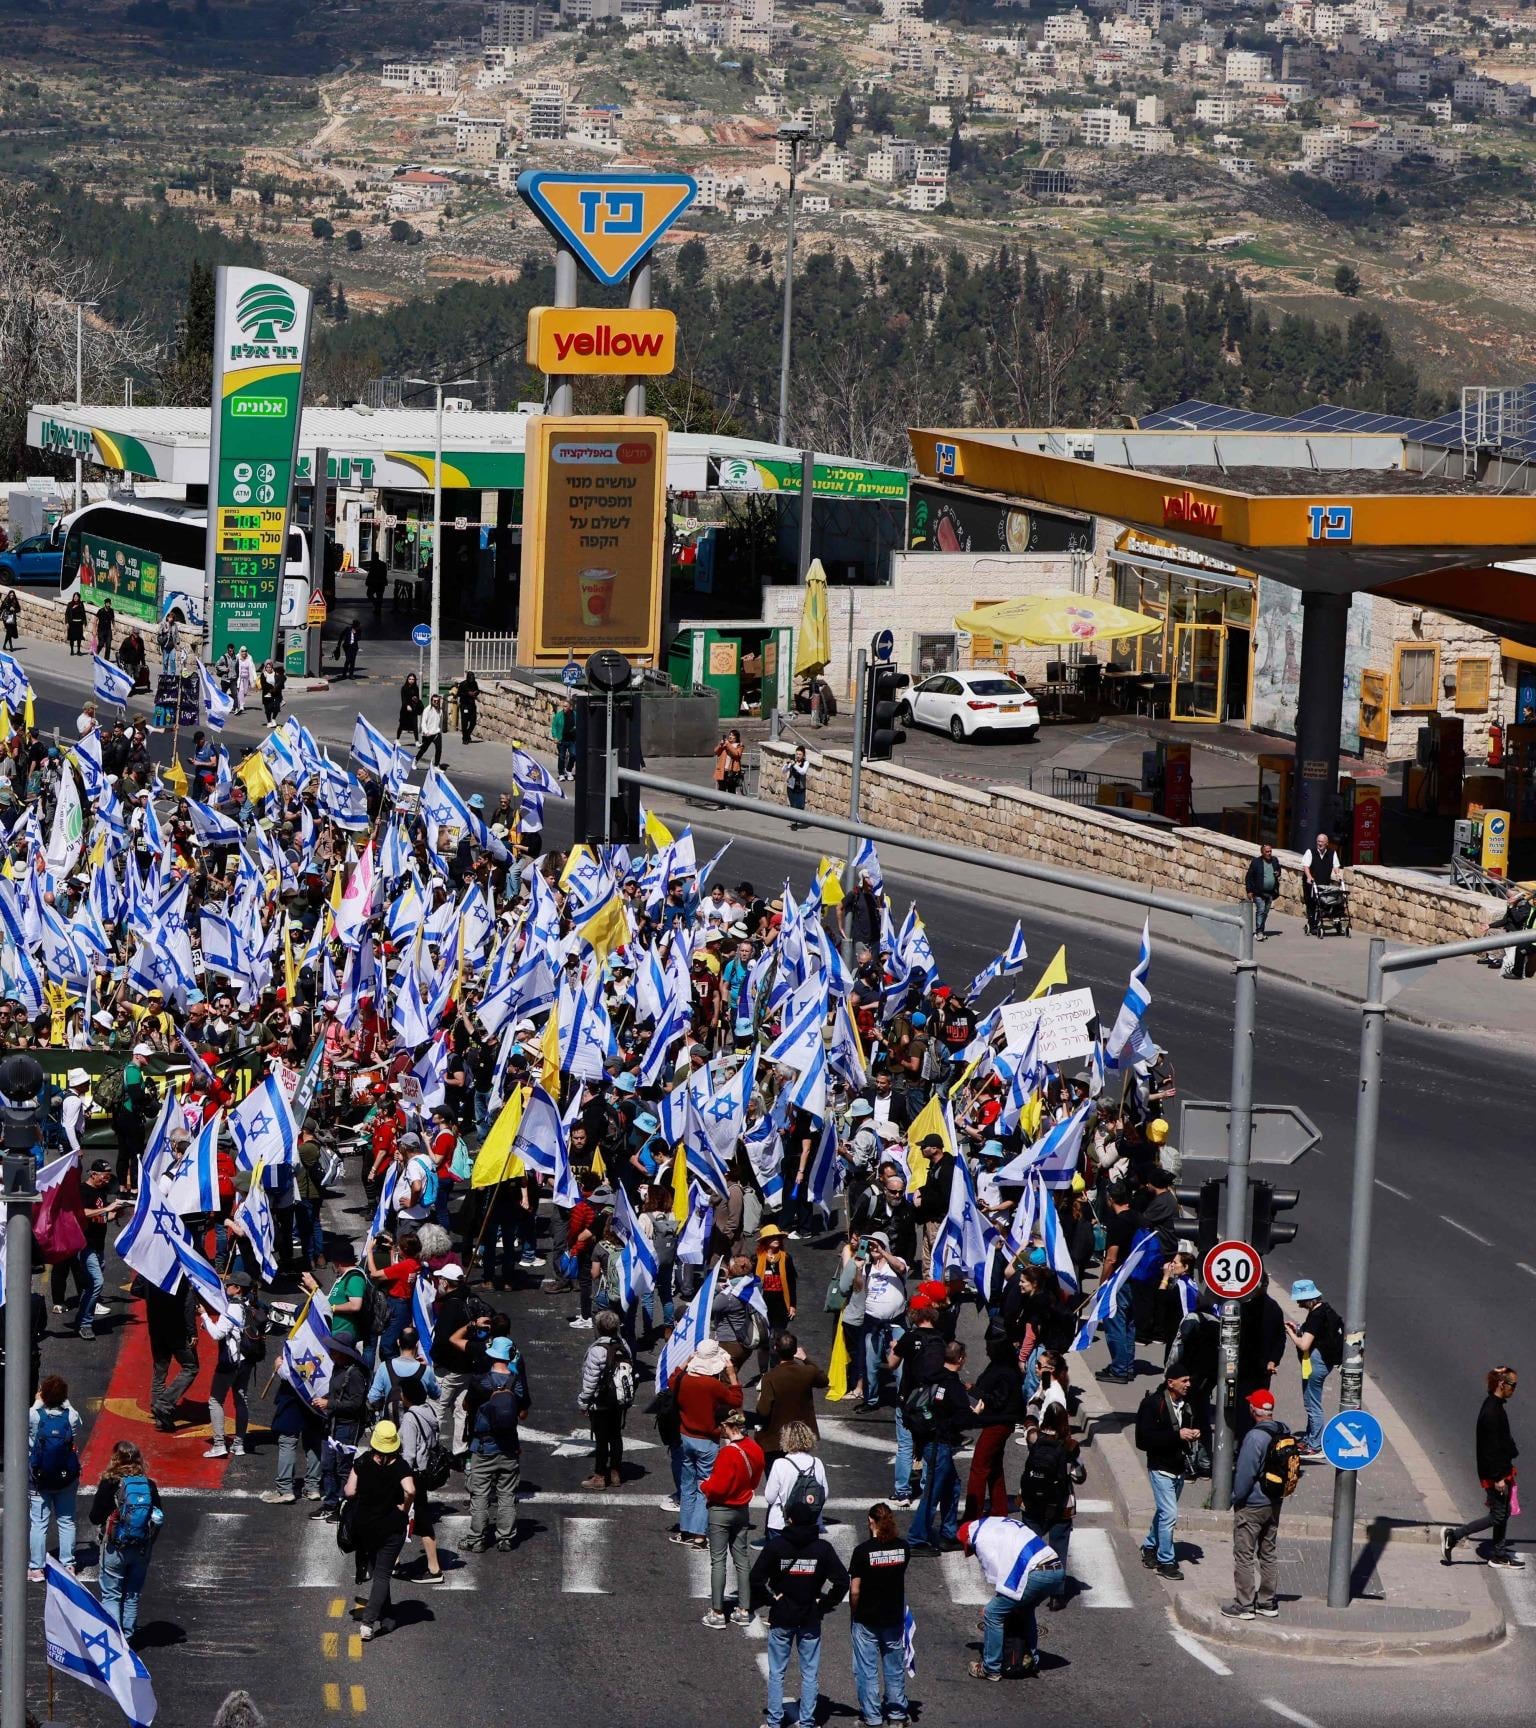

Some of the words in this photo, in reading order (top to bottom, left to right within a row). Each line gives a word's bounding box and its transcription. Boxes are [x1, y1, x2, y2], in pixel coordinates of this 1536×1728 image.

[578, 190, 645, 235] פז
[552, 325, 664, 361] yellow
[230, 342, 270, 361] אלון
[272, 344, 299, 359] דור
[236, 400, 283, 413] אלונית
[41, 419, 69, 448] אלון
[72, 430, 91, 453] דור
[559, 447, 613, 460] באפליקציה
[934, 443, 959, 476] פז
[259, 468, 273, 478] 24
[566, 476, 593, 489] מנוי
[595, 476, 637, 489] עושים
[857, 482, 904, 496] משאיות
[569, 495, 633, 511] ומפסיקים
[1162, 490, 1219, 525] yellow
[260, 509, 282, 521] סולר
[569, 515, 589, 530] על
[591, 515, 631, 530] לשלם
[1307, 504, 1354, 541] פז
[259, 531, 281, 543] סולר
[579, 536, 619, 550] הקפה
[261, 557, 276, 570] 95
[260, 581, 275, 593] 95
[220, 601, 246, 609] שומרת
[248, 601, 268, 609] תחנה
[234, 609, 253, 617] שבת
[1215, 1258, 1251, 1283] 30
